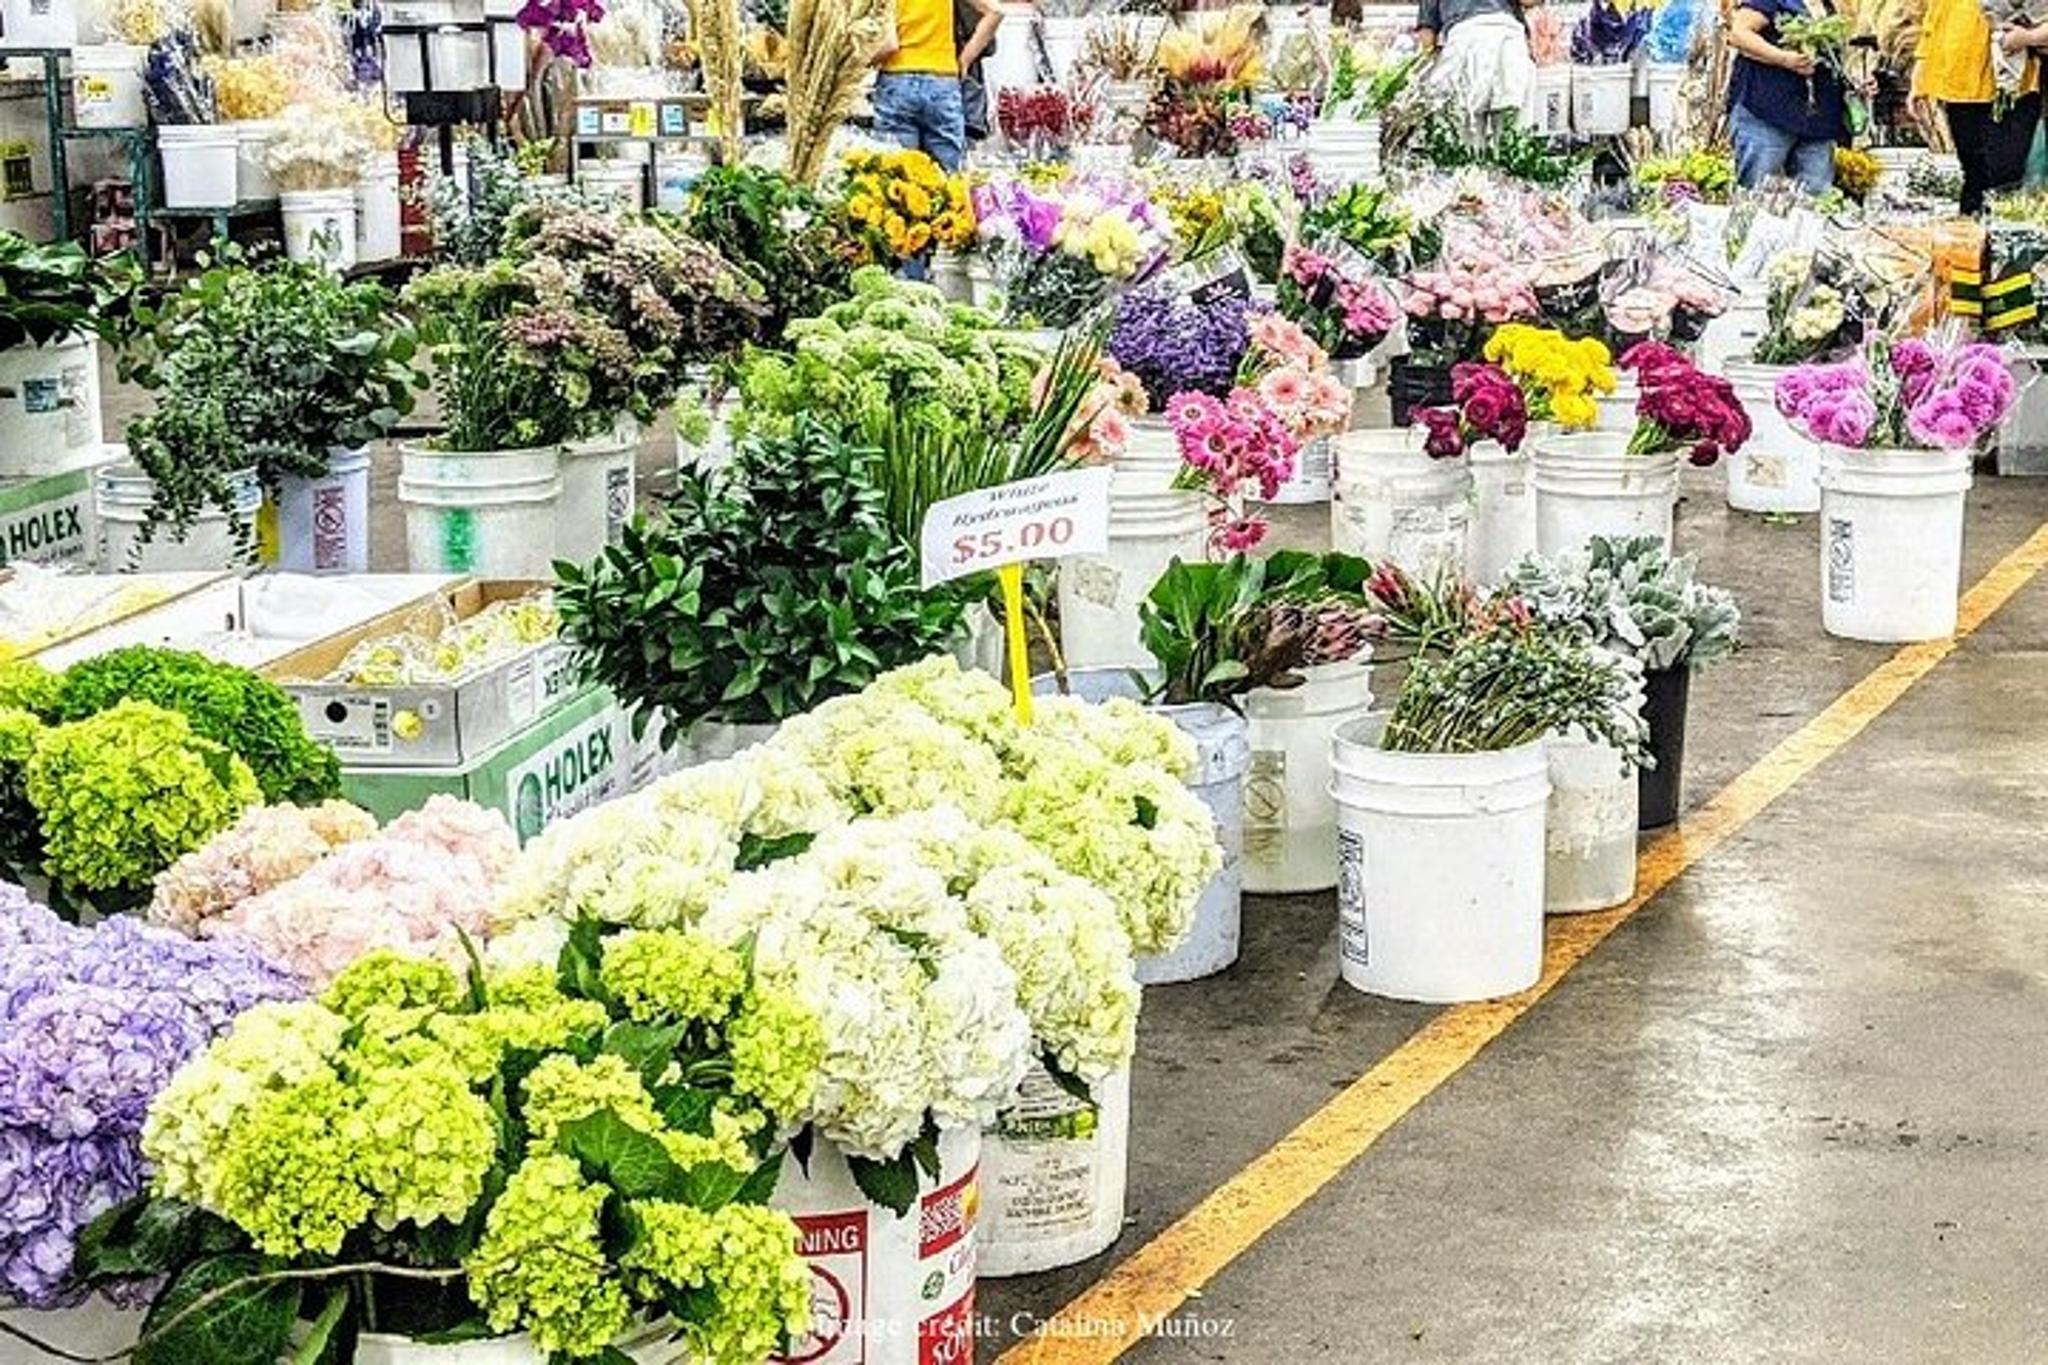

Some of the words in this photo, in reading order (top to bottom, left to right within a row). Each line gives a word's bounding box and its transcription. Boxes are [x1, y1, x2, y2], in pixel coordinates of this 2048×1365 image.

[9, 504, 82, 556] HOLEX
[952, 516, 1074, 564] $5.00
[545, 722, 614, 801] HOLEX
